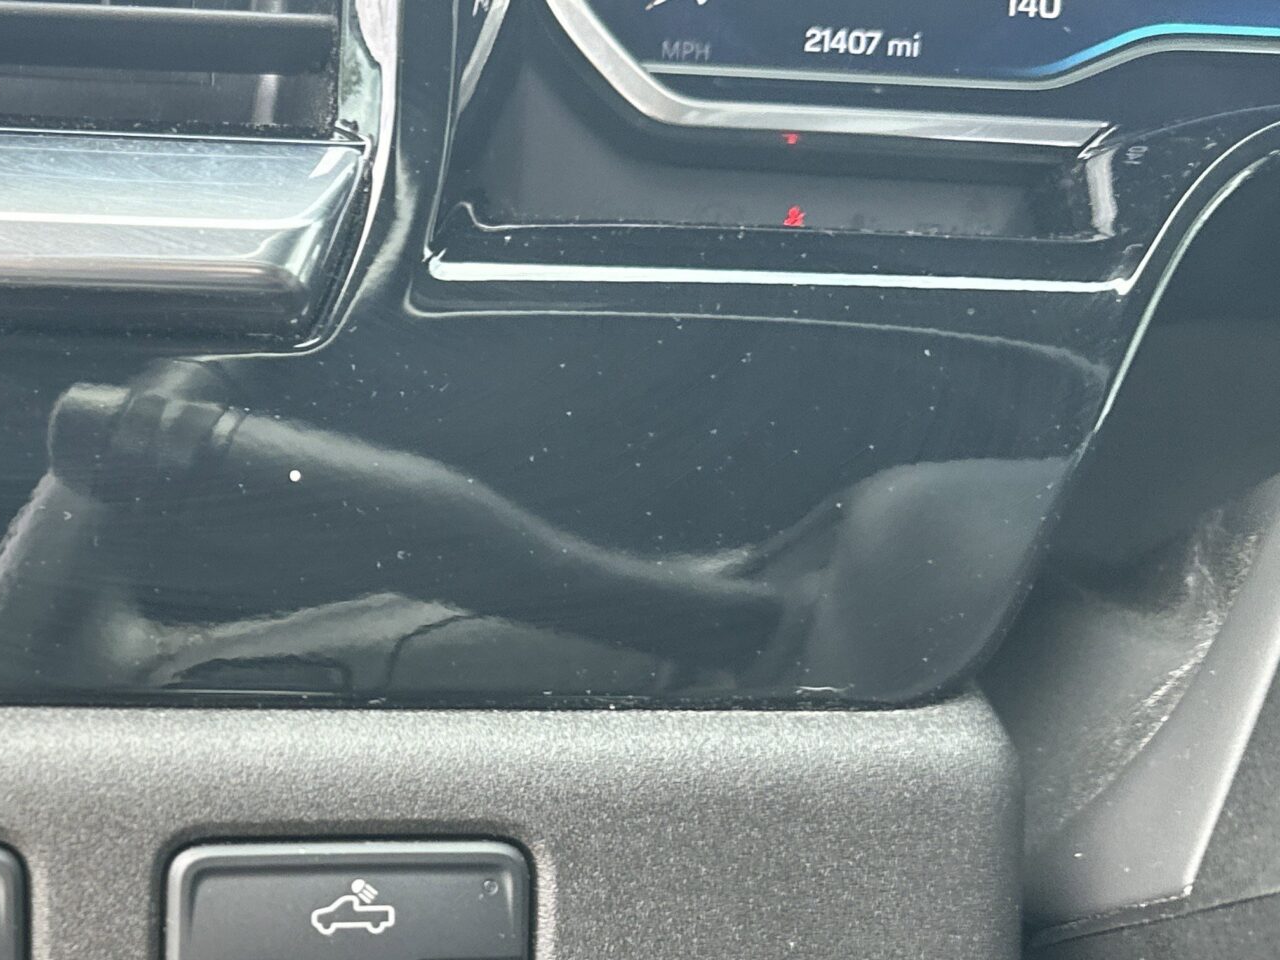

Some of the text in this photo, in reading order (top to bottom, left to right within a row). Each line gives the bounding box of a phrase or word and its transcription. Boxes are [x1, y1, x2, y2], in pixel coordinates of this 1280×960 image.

[1007, 0, 1061, 19] 140
[662, 40, 710, 61] MPH
[804, 26, 921, 57] 21407 mi
